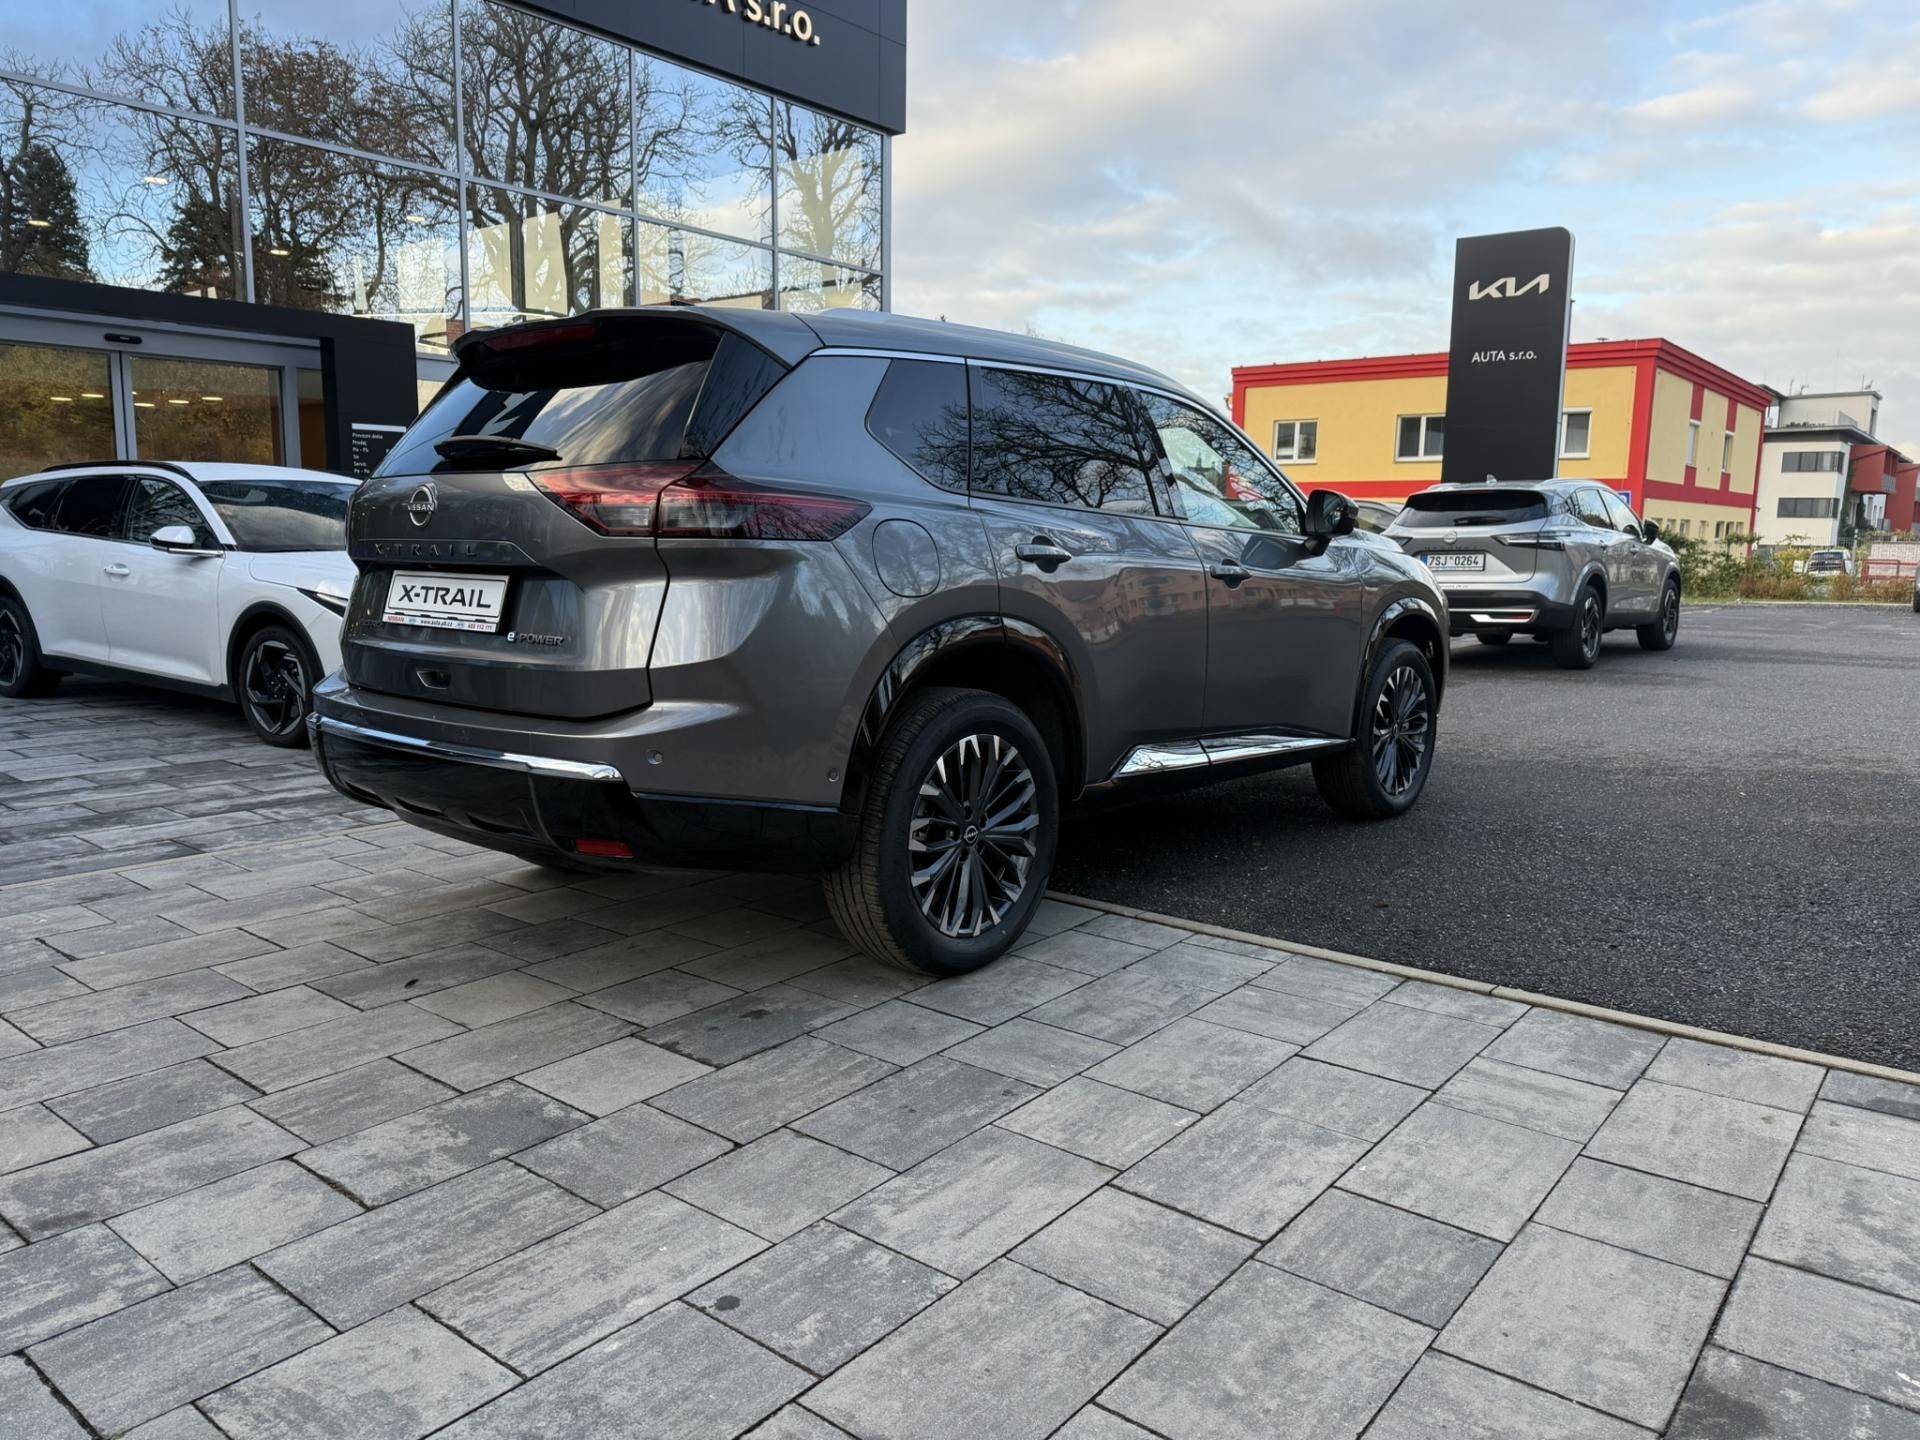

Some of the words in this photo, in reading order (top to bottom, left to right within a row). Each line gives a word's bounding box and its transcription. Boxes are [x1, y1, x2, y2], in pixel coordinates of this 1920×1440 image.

[745, 0, 820, 45] s.r.o.
[1469, 273, 1550, 300] KIA
[1472, 350, 1506, 362] AUTA
[1509, 350, 1537, 360] s.r.o.
[407, 503, 435, 511] NISSAN
[374, 543, 478, 557] X-TRAIL
[1429, 556, 1448, 566] 7SJ
[1454, 556, 1479, 566] 0264
[398, 584, 492, 609] X-TRAIL
[507, 631, 565, 646] e-POWER
